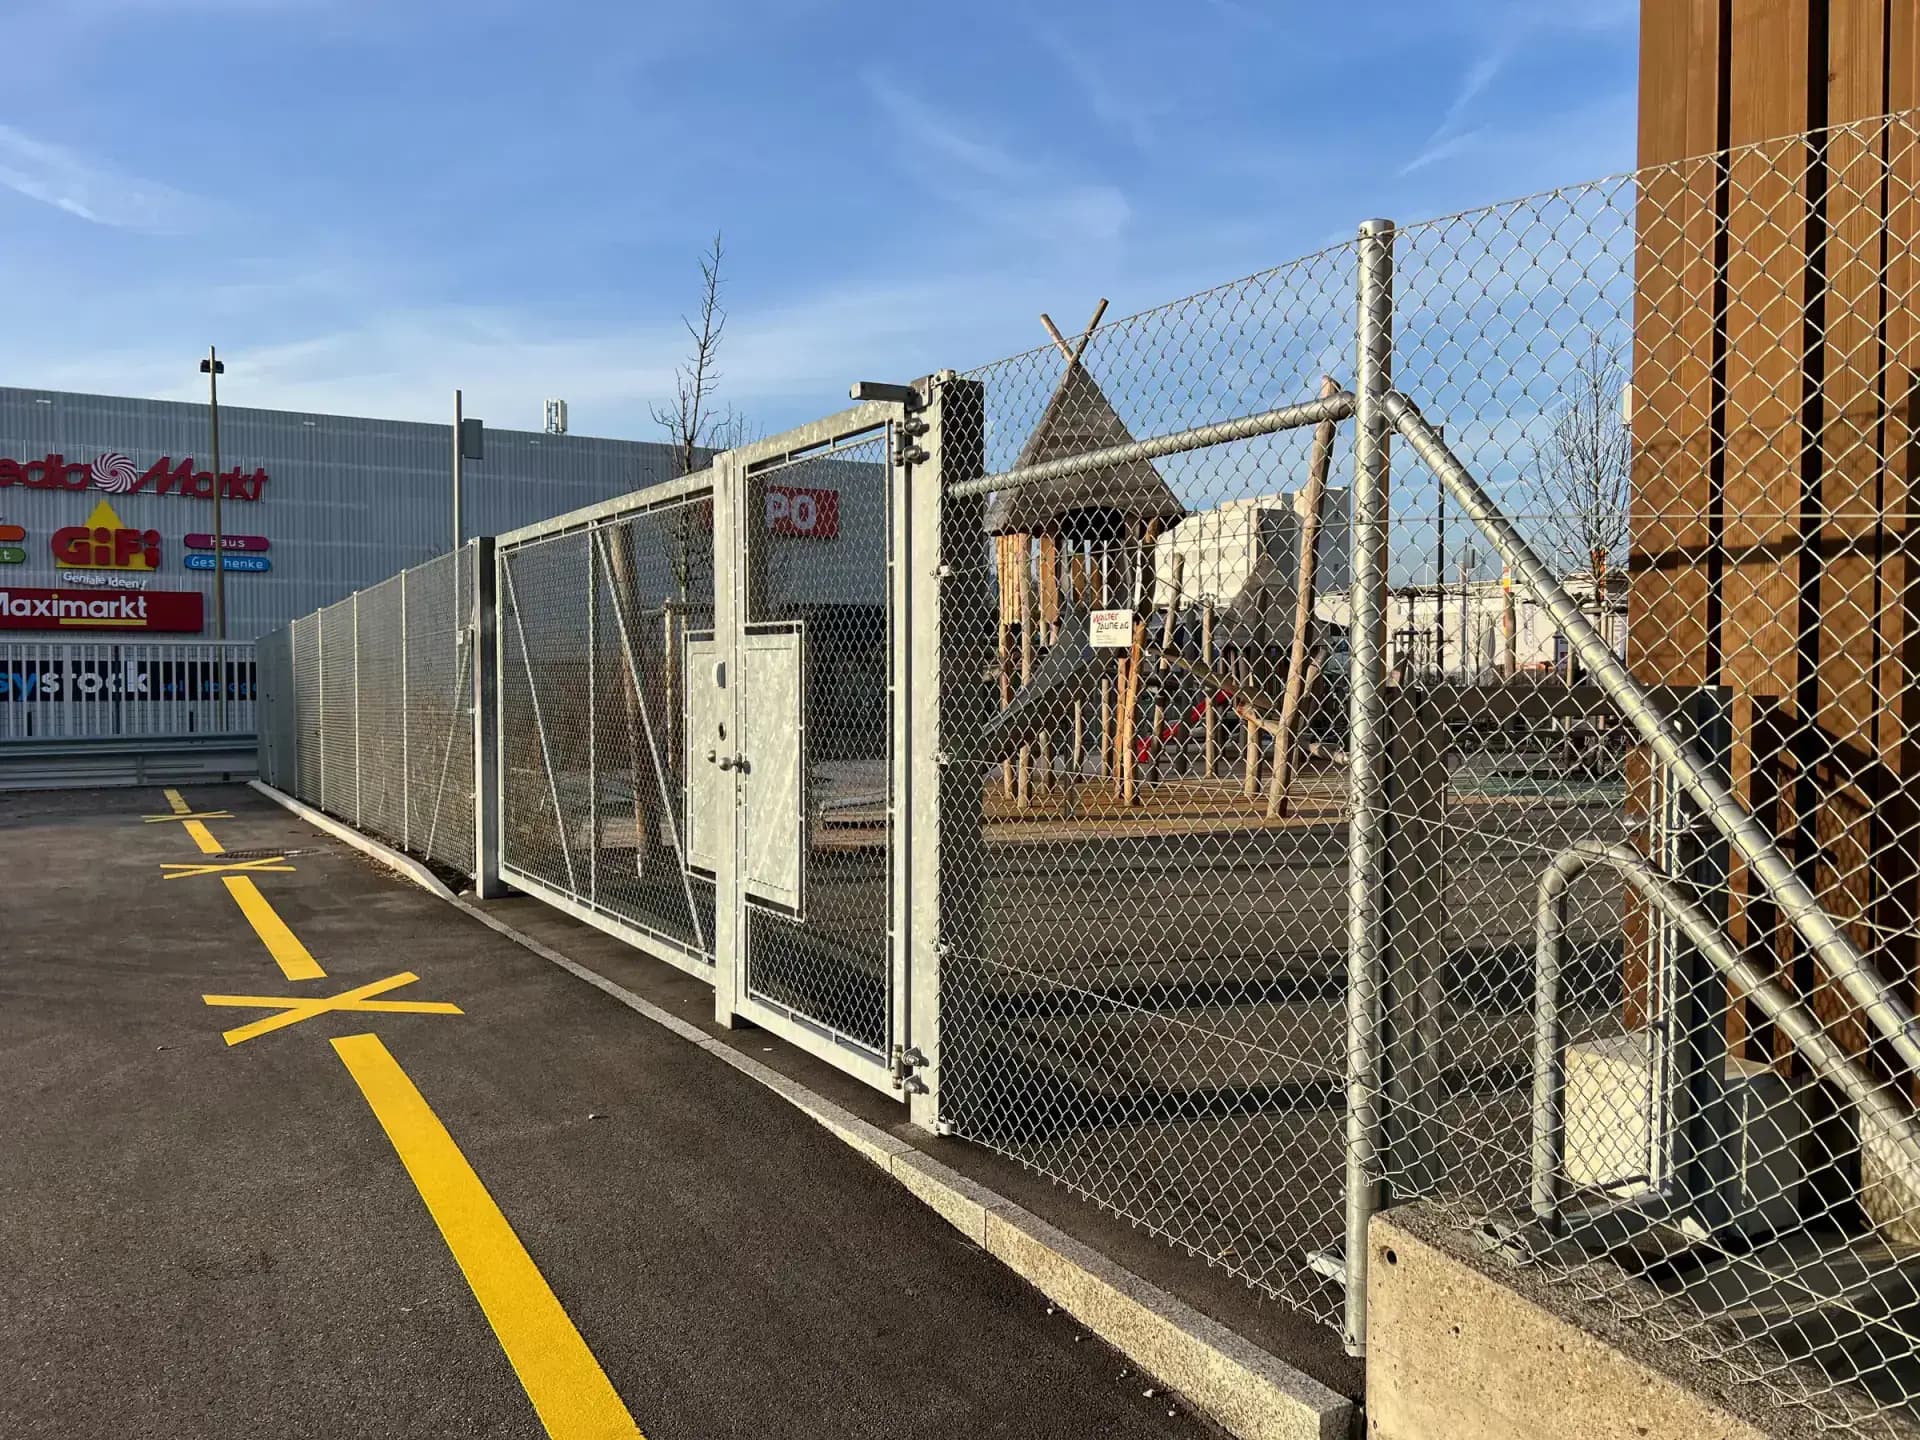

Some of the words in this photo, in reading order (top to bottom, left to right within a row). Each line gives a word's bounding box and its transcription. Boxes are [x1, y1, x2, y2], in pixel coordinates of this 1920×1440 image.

[128, 456, 268, 502] Markt
[191, 556, 263, 569] Geshenke
[63, 571, 105, 585] Geniale
